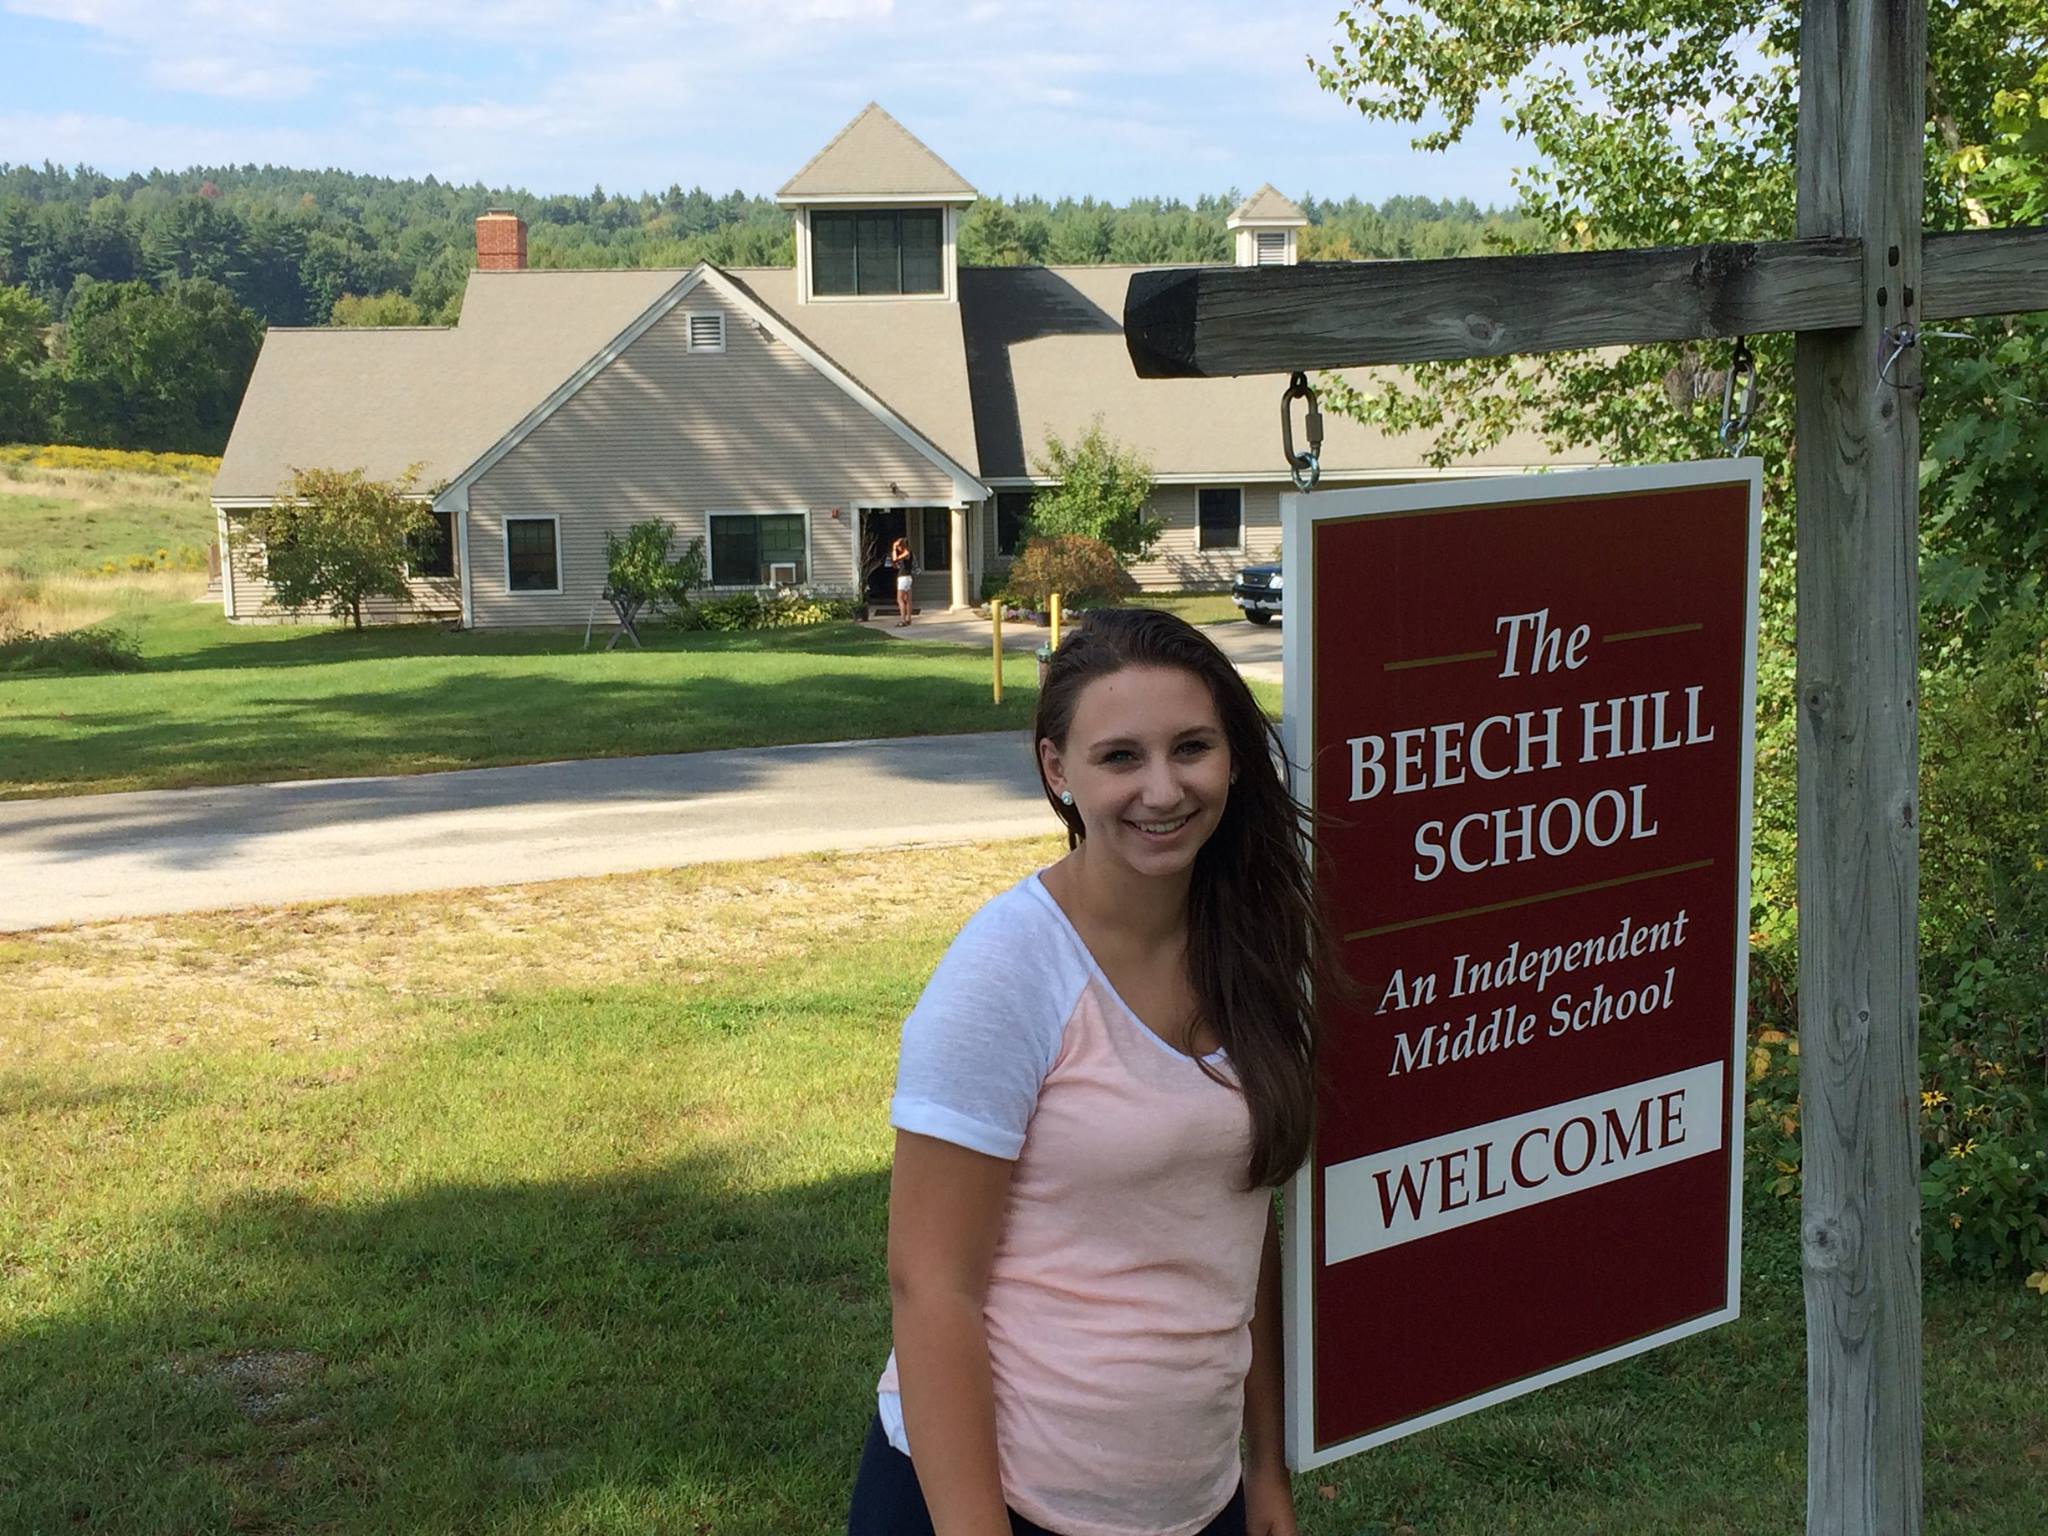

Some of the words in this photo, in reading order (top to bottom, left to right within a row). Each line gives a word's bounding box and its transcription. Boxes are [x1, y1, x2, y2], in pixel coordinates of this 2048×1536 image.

[1495, 608, 1591, 679] The
[1346, 707, 1563, 802] BEECH
[1579, 685, 1715, 764] HILL
[1413, 784, 1659, 882] SCHOOL
[1374, 968, 1437, 1016] An
[1448, 909, 1690, 999] Independent
[1388, 1008, 1536, 1077] Middle
[1548, 967, 1677, 1038] School
[1371, 1088, 1687, 1230] WELCOME
